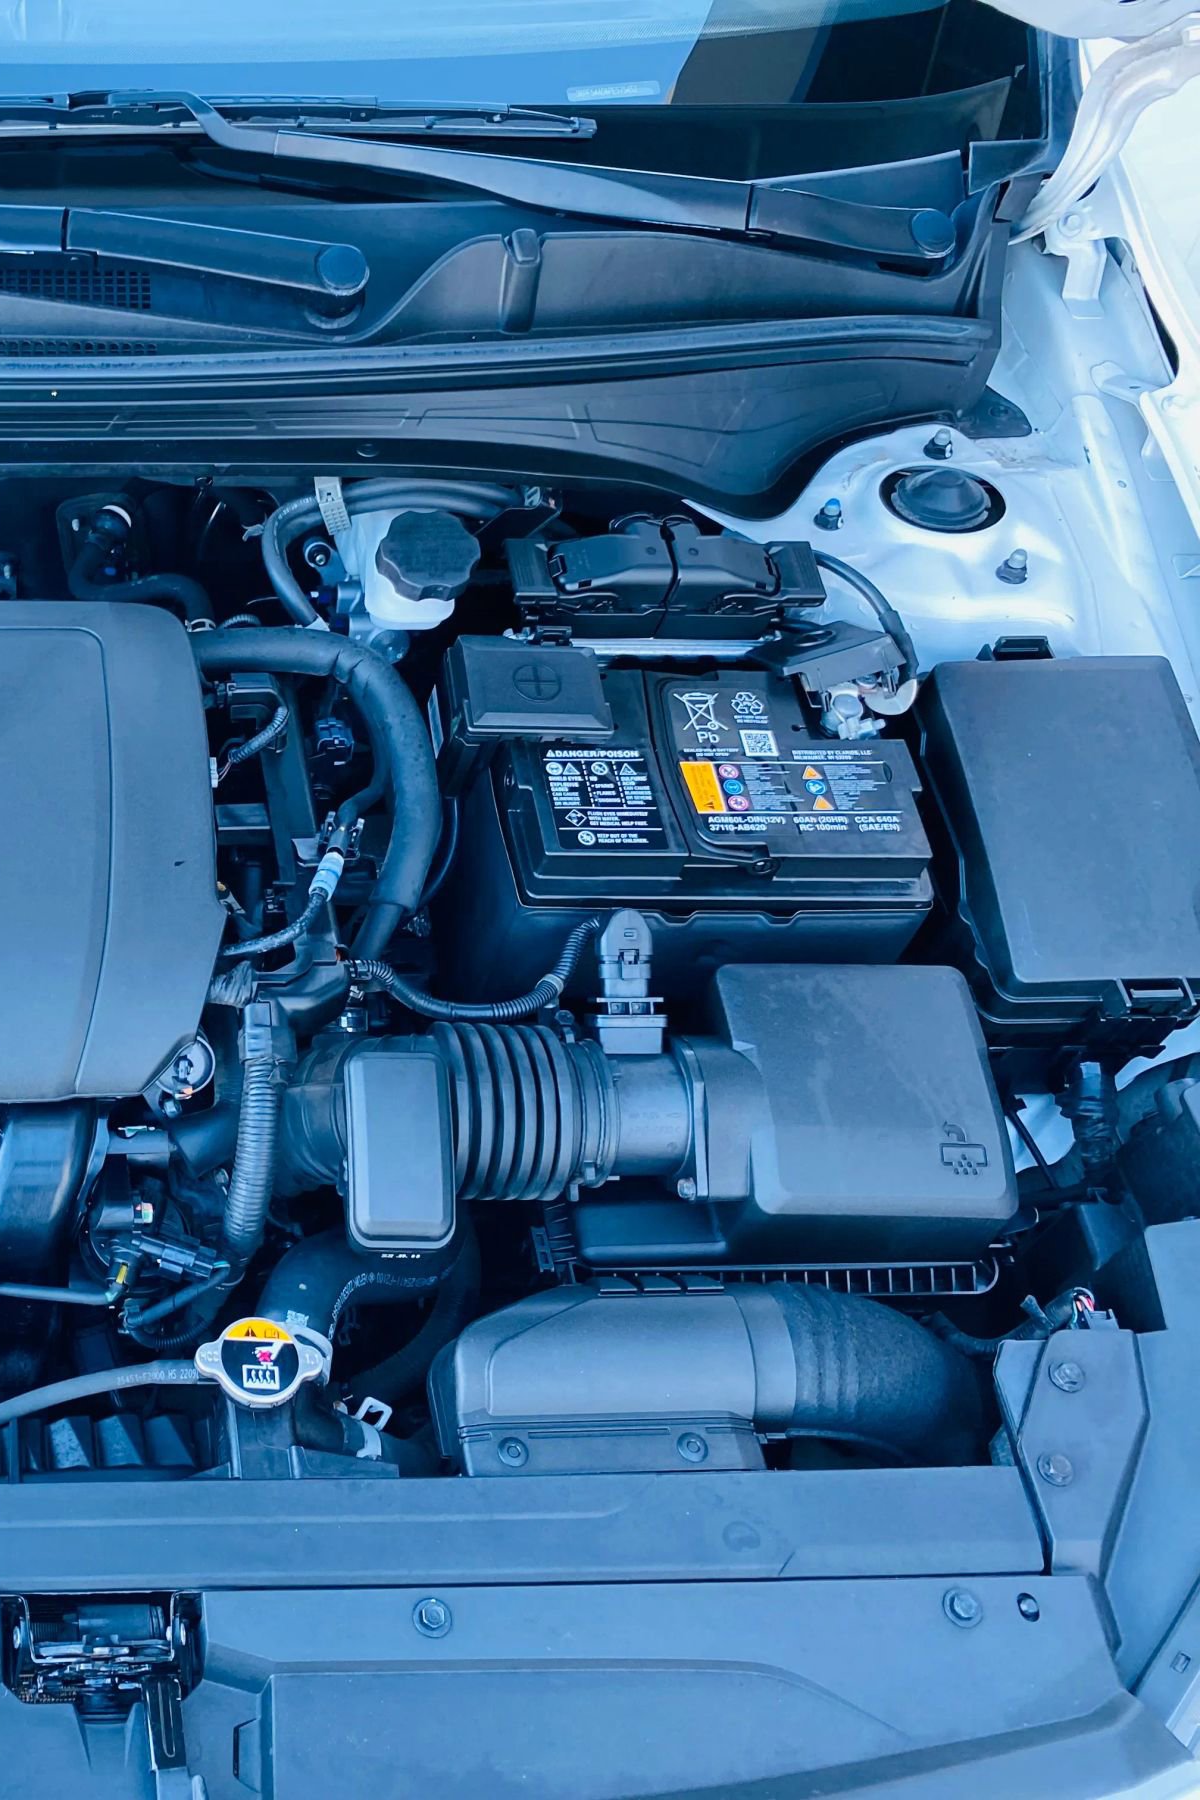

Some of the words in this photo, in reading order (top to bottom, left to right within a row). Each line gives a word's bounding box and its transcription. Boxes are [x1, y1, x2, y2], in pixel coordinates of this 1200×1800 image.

[697, 731, 720, 743] Pb
[555, 750, 640, 758] DANGER/POISON
[708, 816, 786, 824] AGM60L-DIN(12V)
[818, 816, 849, 824] (20HR)
[858, 824, 900, 832] (SAE/EN)
